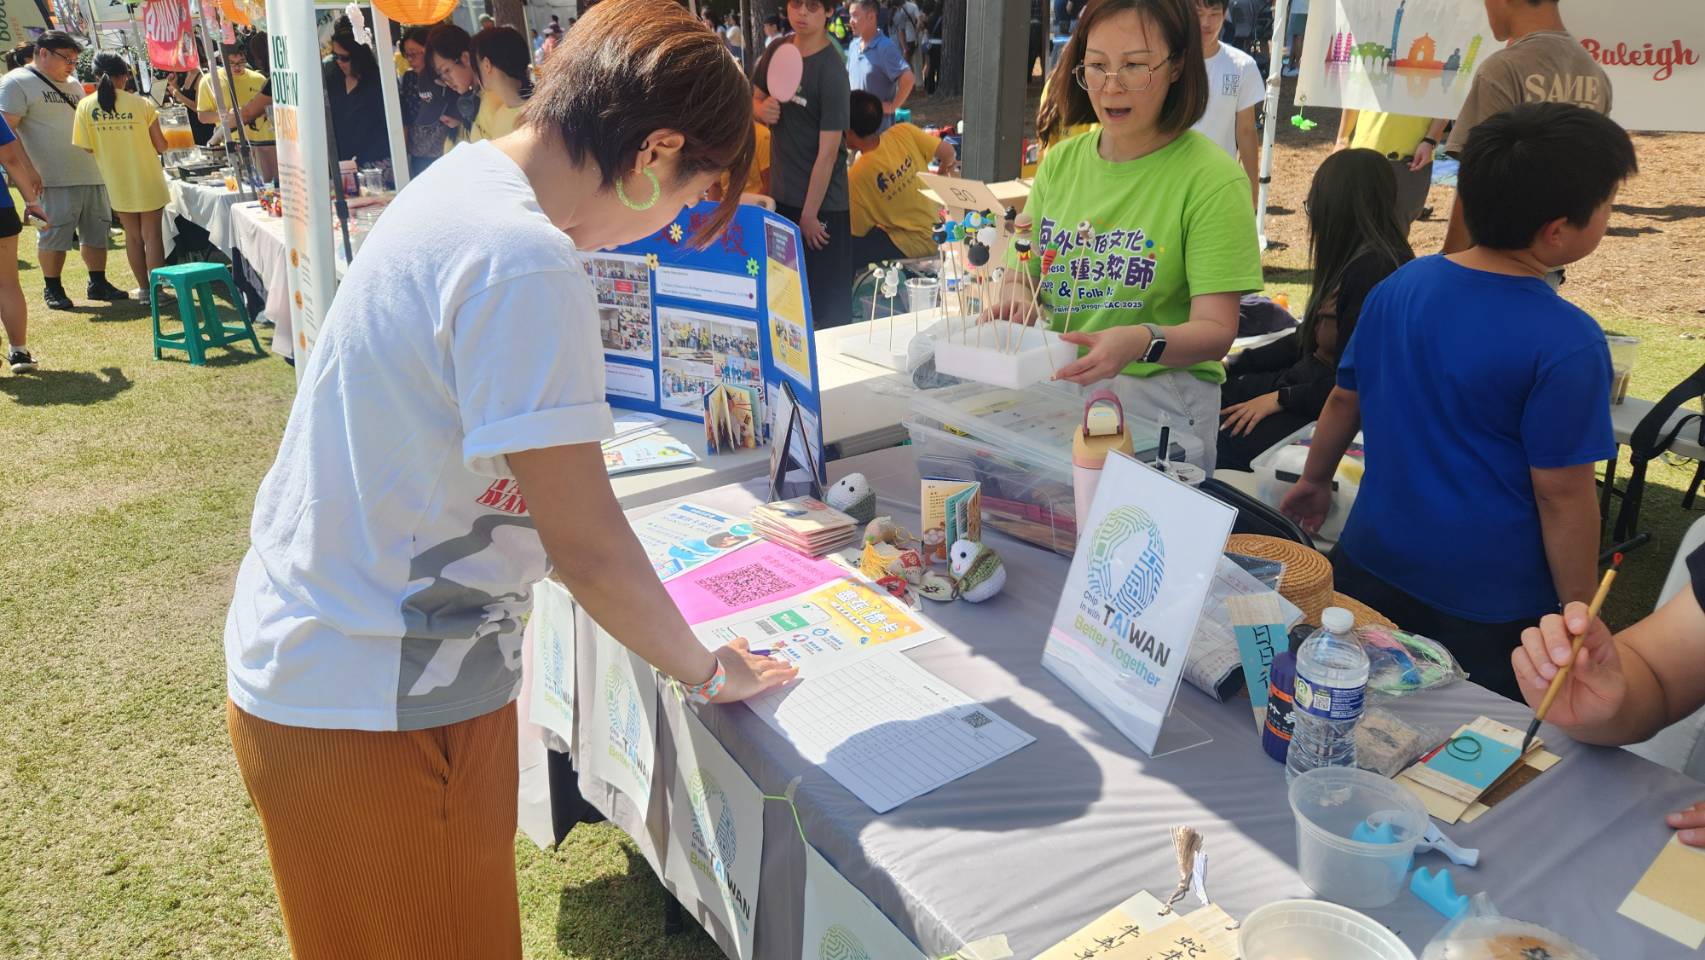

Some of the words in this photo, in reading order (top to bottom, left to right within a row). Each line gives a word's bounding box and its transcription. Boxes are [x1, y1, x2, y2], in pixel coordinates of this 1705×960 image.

[1071, 253, 1155, 289] 種子教師
[1058, 281, 1072, 298] &
[1084, 590, 1098, 606] Chip
[1074, 614, 1107, 647] Better
[1111, 640, 1160, 688] Together
[1102, 604, 1171, 667] TAIWAN
